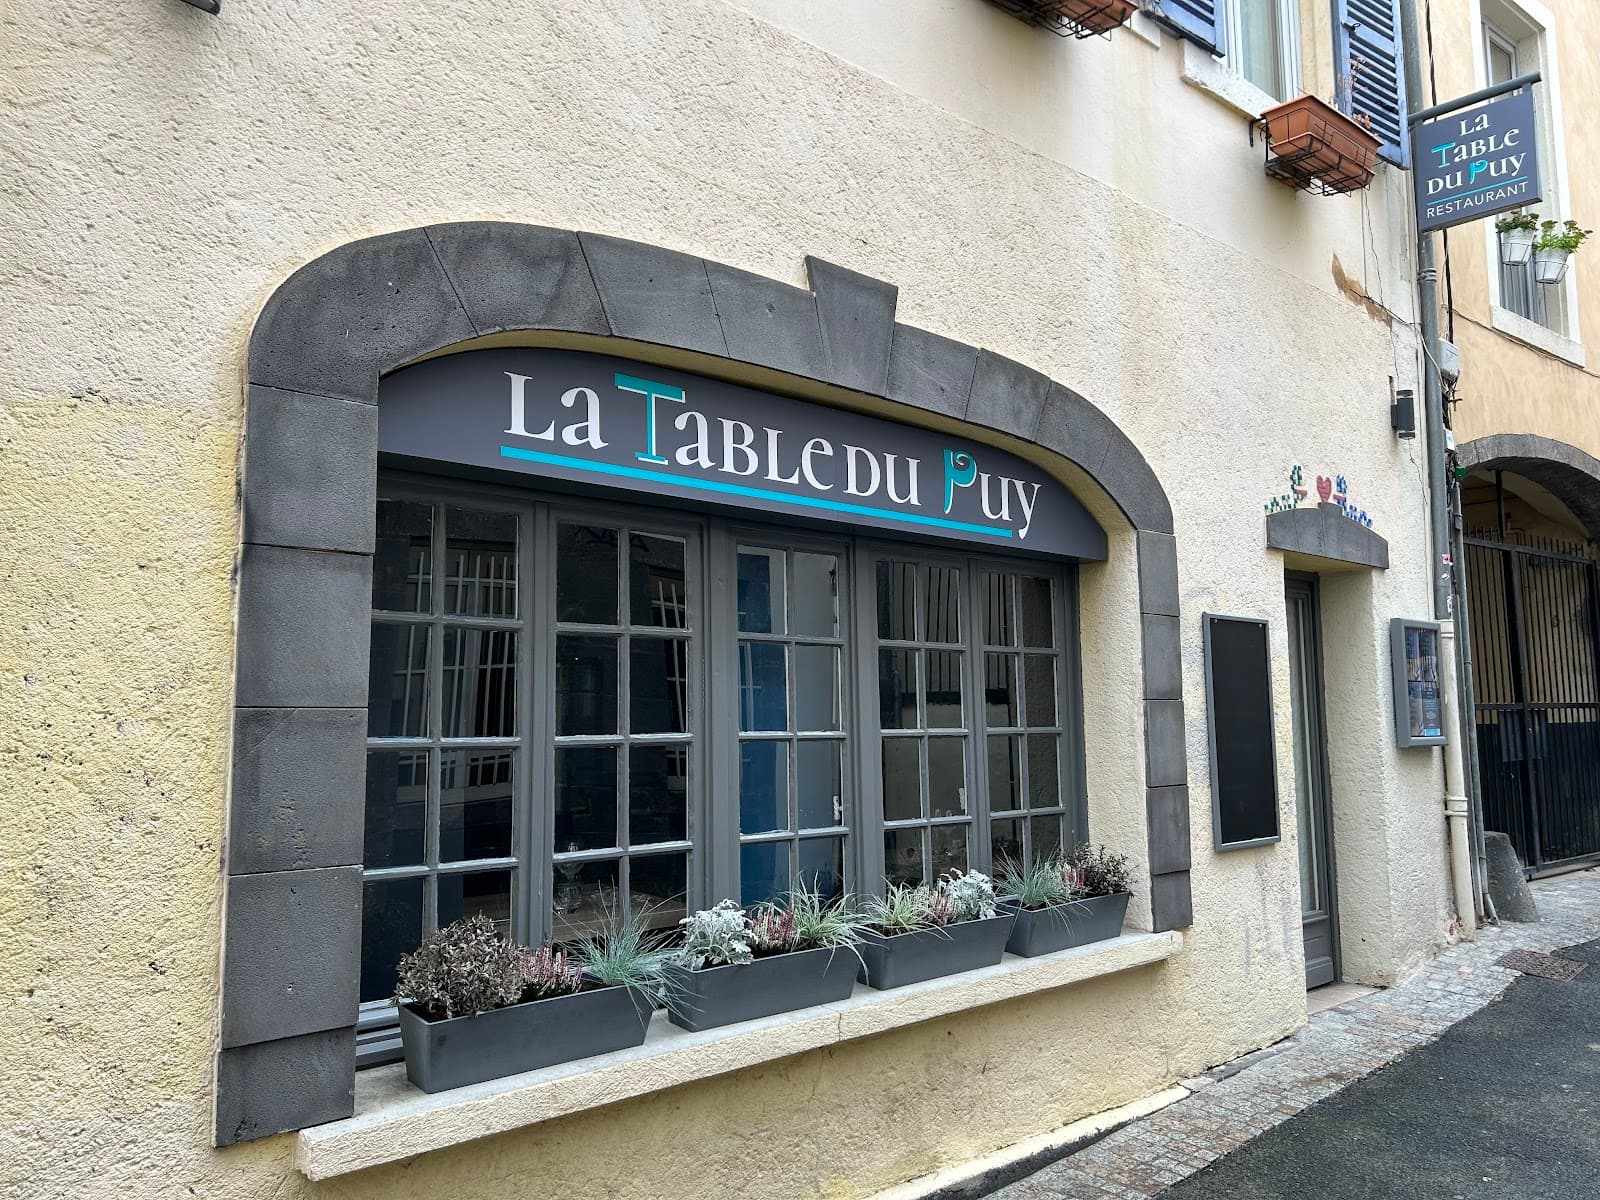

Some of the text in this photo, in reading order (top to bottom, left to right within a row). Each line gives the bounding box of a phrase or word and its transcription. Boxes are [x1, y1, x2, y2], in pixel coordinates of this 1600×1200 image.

[1459, 113, 1490, 137] La
[1427, 181, 1529, 219] RESTAURANT
[503, 371, 608, 449] La
